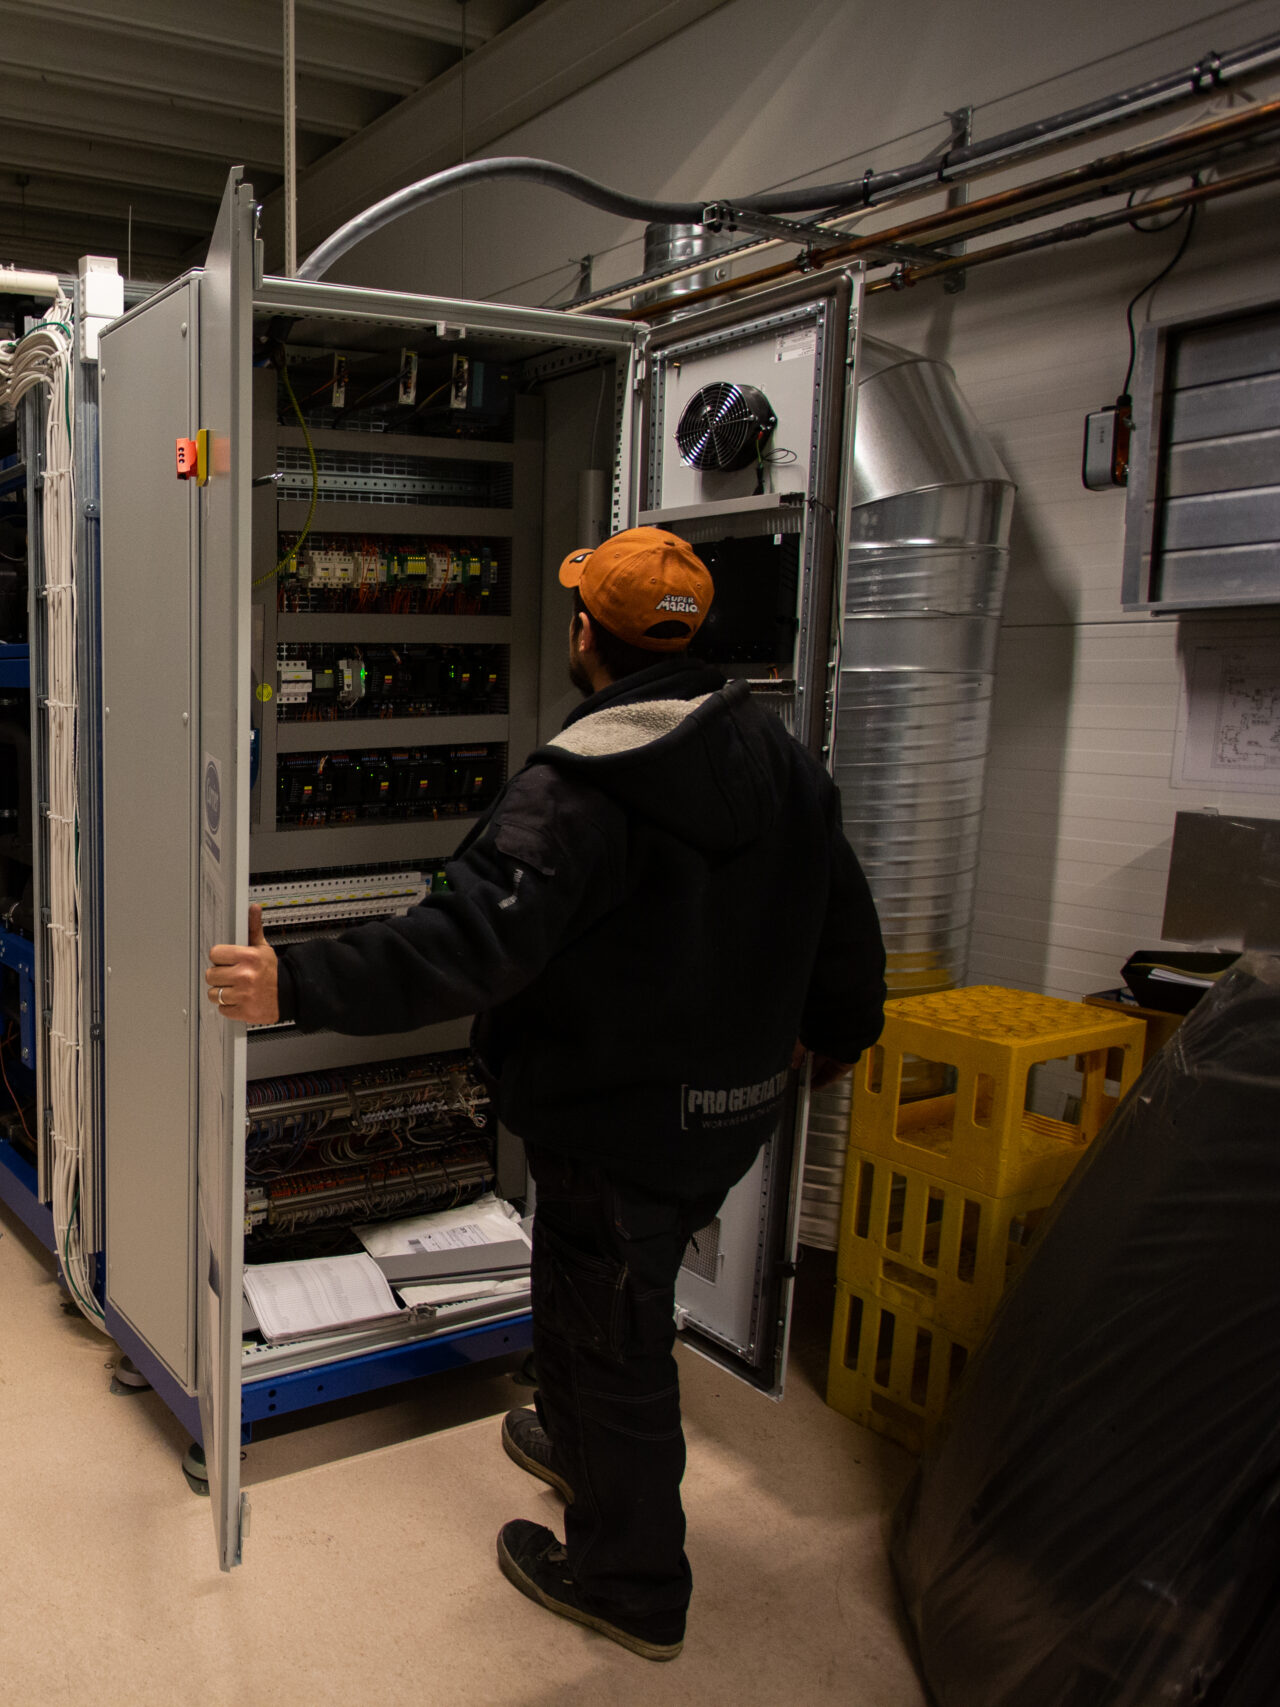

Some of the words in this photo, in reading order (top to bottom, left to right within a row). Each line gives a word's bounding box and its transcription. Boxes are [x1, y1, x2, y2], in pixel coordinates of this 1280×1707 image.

[664, 594, 694, 603] SUPER
[655, 600, 698, 612] MARIO
[688, 1089, 727, 1114] PRO
